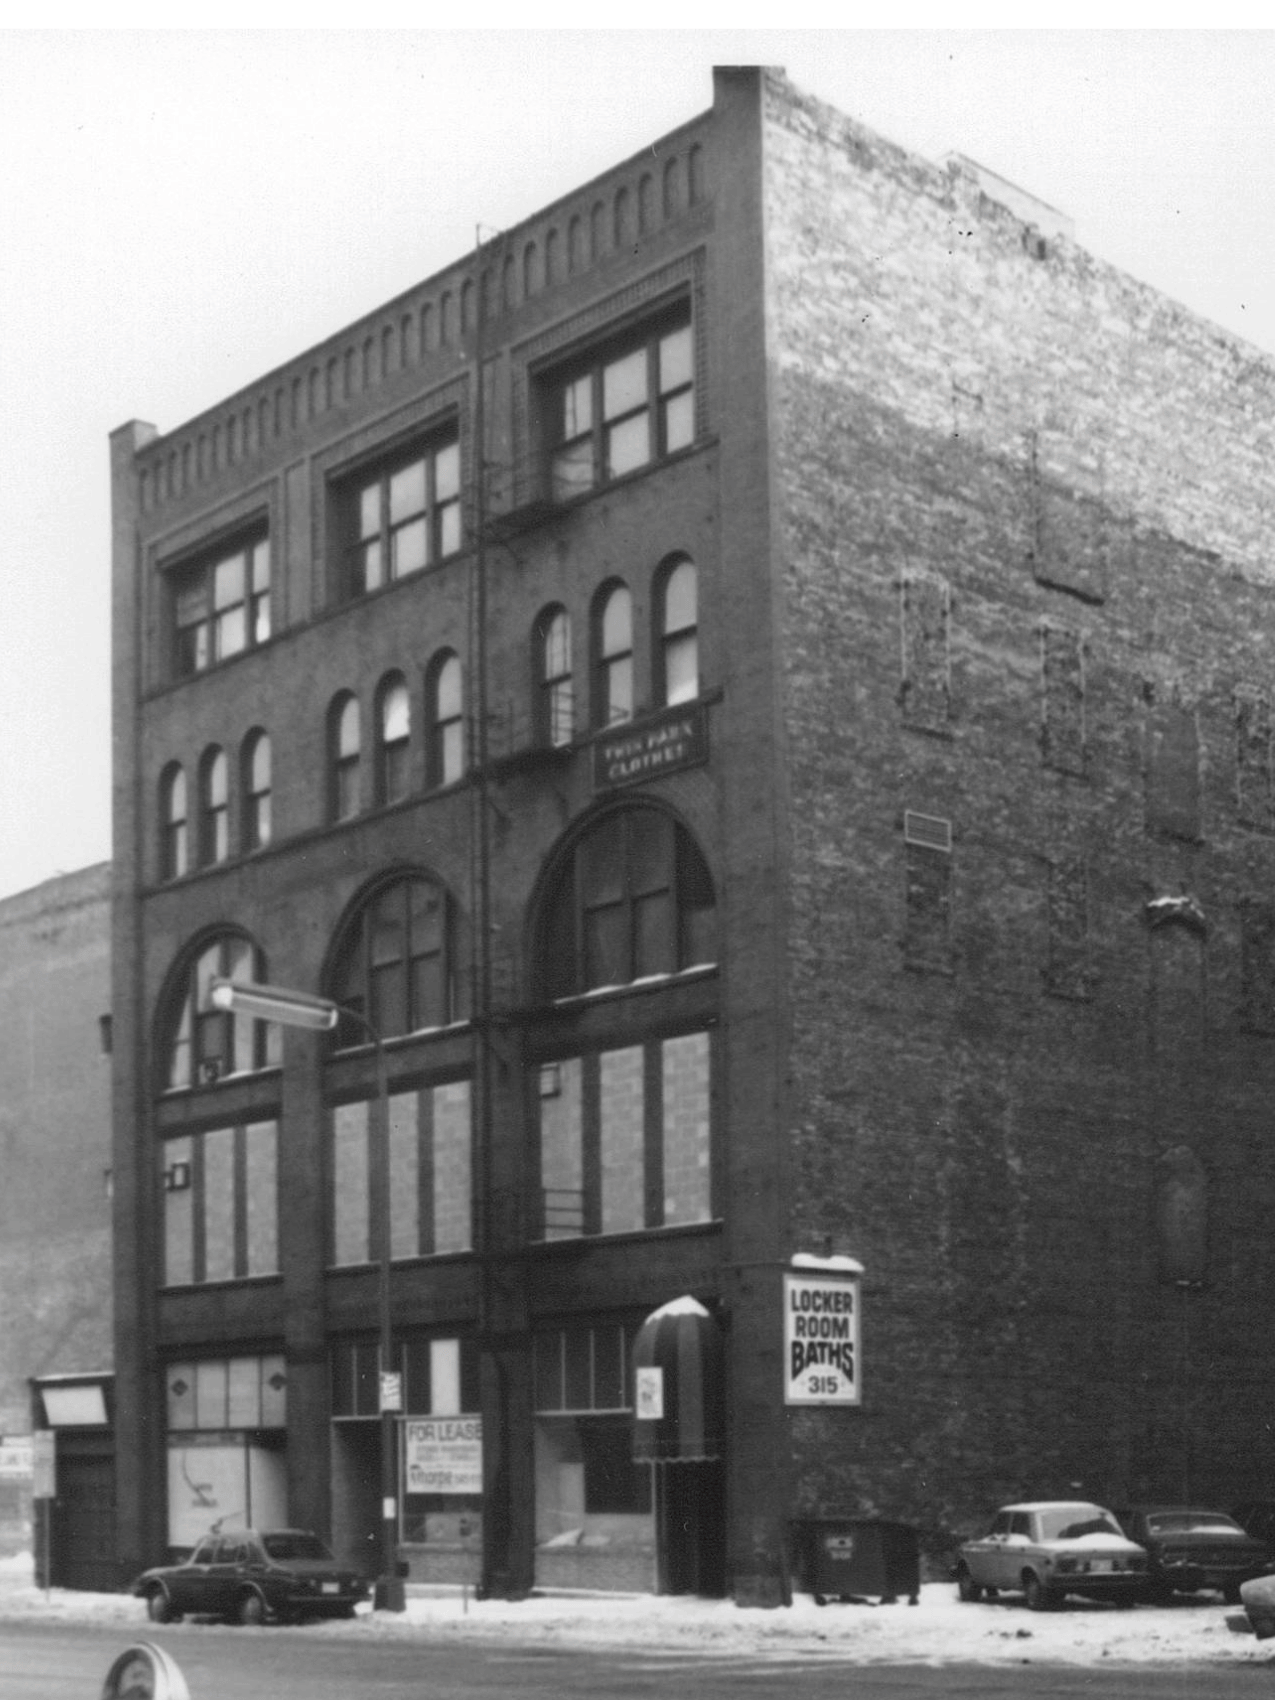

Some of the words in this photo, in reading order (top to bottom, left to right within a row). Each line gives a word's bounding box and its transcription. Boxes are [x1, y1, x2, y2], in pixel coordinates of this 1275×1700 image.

[791, 1288, 853, 1314] LOCKER
[795, 1315, 849, 1339] ROOM
[791, 1341, 854, 1384] BATHS
[808, 1375, 839, 1394] 315
[409, 1424, 434, 1443] FOR
[438, 1423, 482, 1442] LEASE
